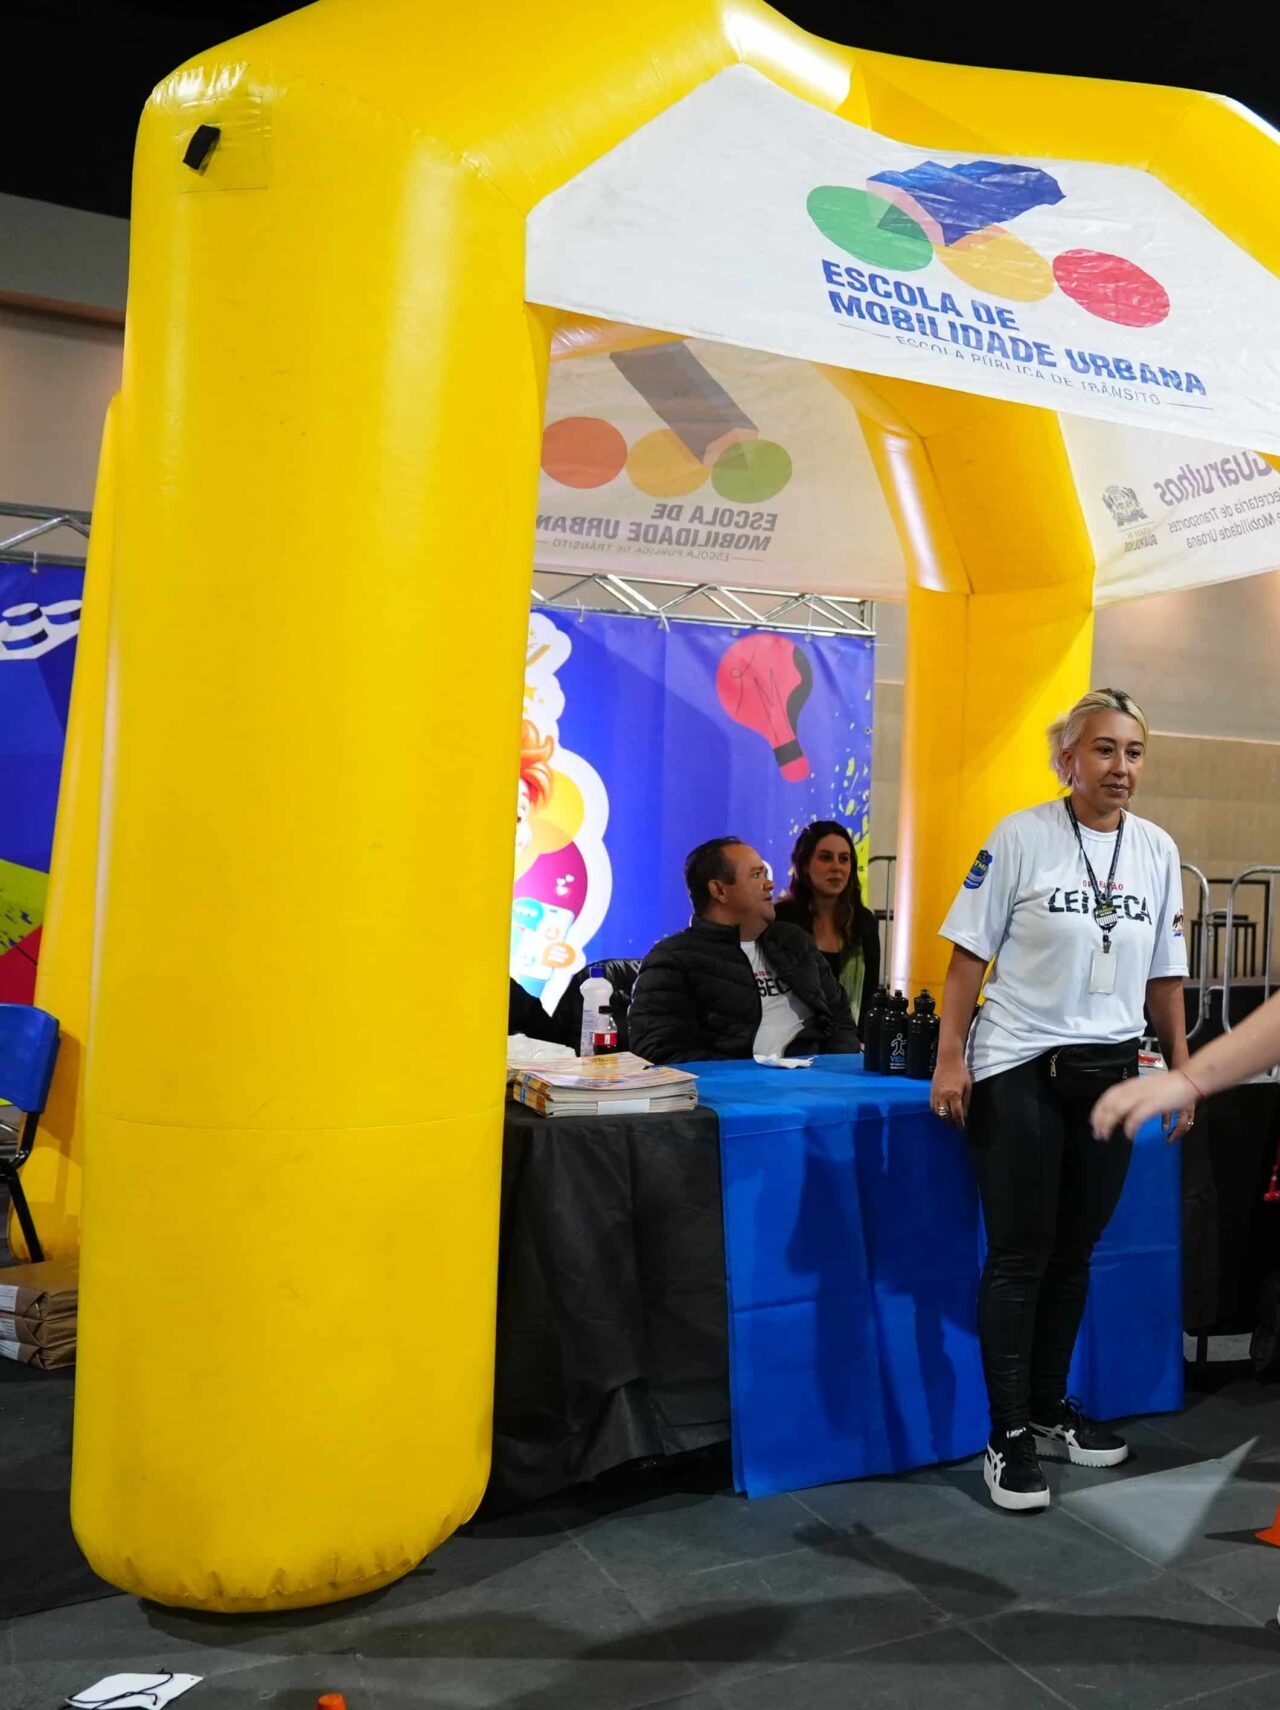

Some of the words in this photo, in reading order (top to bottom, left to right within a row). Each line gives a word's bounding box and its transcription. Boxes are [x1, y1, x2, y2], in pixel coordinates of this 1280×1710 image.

[821, 260, 963, 317] ESCOLA
[971, 299, 1020, 331] DE
[828, 291, 1057, 368] MOBILIDADE
[1064, 348, 1207, 397] URBANA
[1051, 373, 1073, 387] DE
[1081, 381, 1161, 406] TRÂNSITO
[1048, 887, 1089, 914] LEI
[1105, 894, 1152, 925] ECA
[755, 976, 792, 998] SEC
